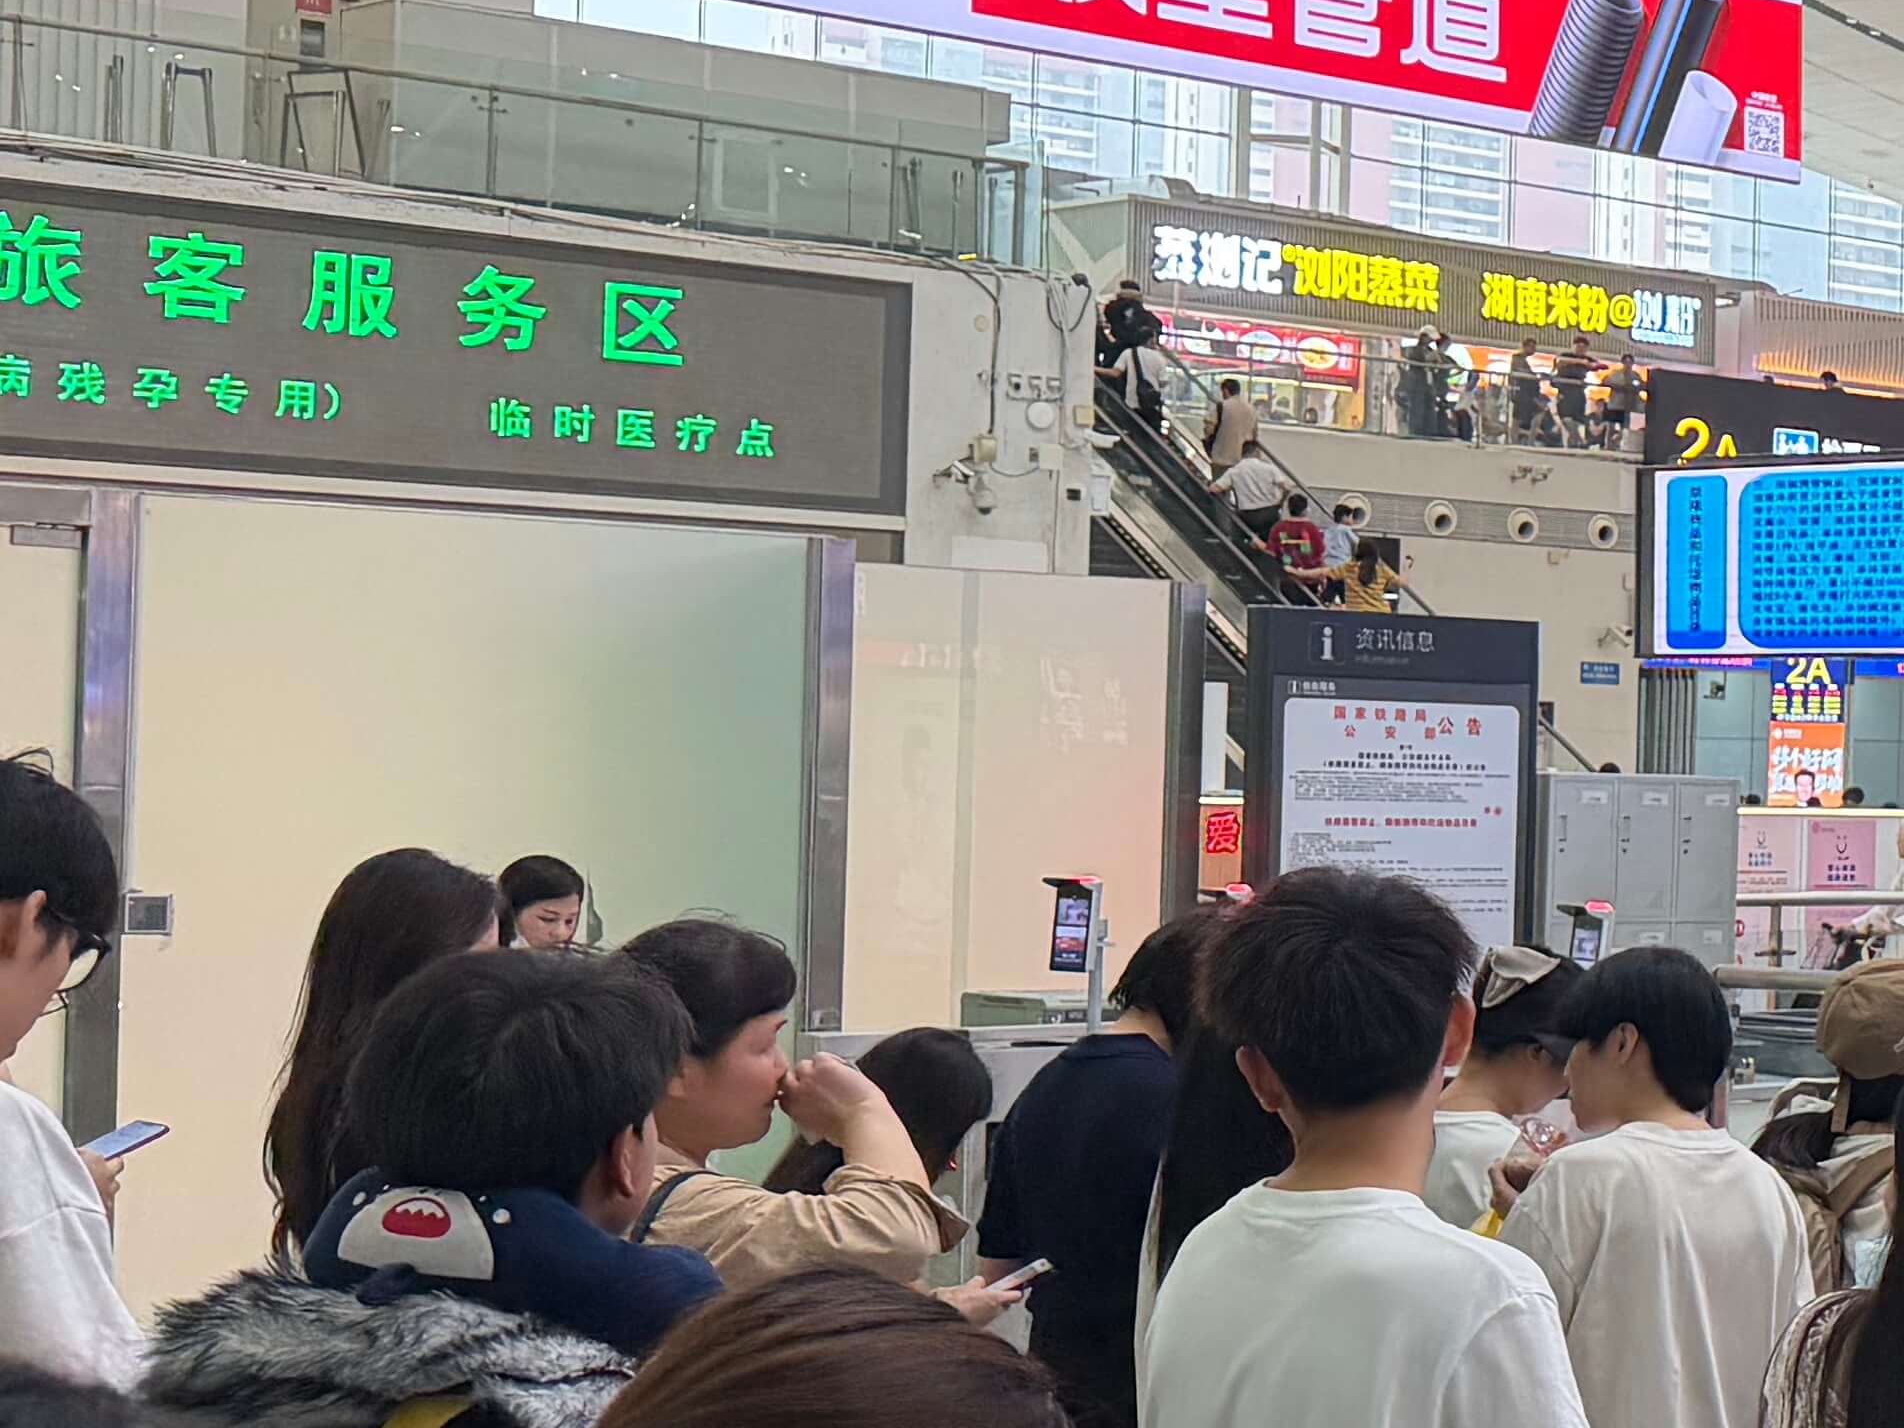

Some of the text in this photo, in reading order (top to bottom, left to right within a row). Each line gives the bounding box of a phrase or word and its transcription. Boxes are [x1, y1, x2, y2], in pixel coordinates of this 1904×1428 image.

[0, 210, 684, 366] 旅客服务区
[1294, 244, 1440, 313] 浏阳蒸菜
[489, 397, 775, 458] 临时医疗点
[1355, 627, 1436, 653] 资讯信息
[1785, 657, 1832, 684] 2A
